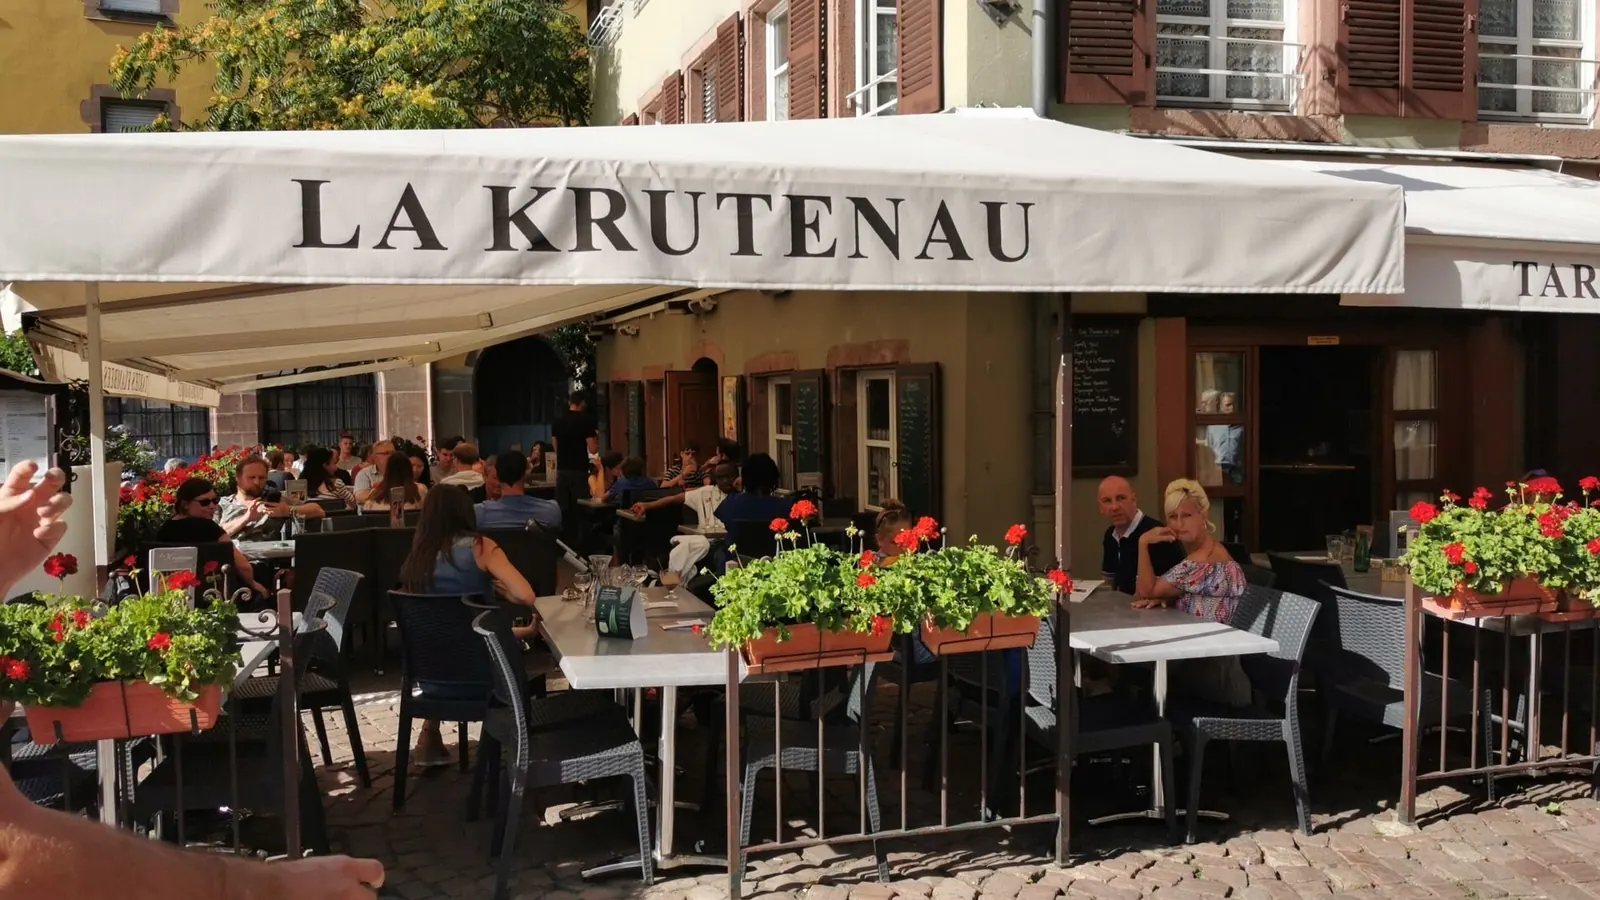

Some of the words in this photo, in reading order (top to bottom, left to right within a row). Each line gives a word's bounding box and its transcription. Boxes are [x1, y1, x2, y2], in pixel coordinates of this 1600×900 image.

[291, 179, 449, 251] LA
[482, 184, 1036, 263] KRUTENAU
[1512, 260, 1600, 299] TAR
